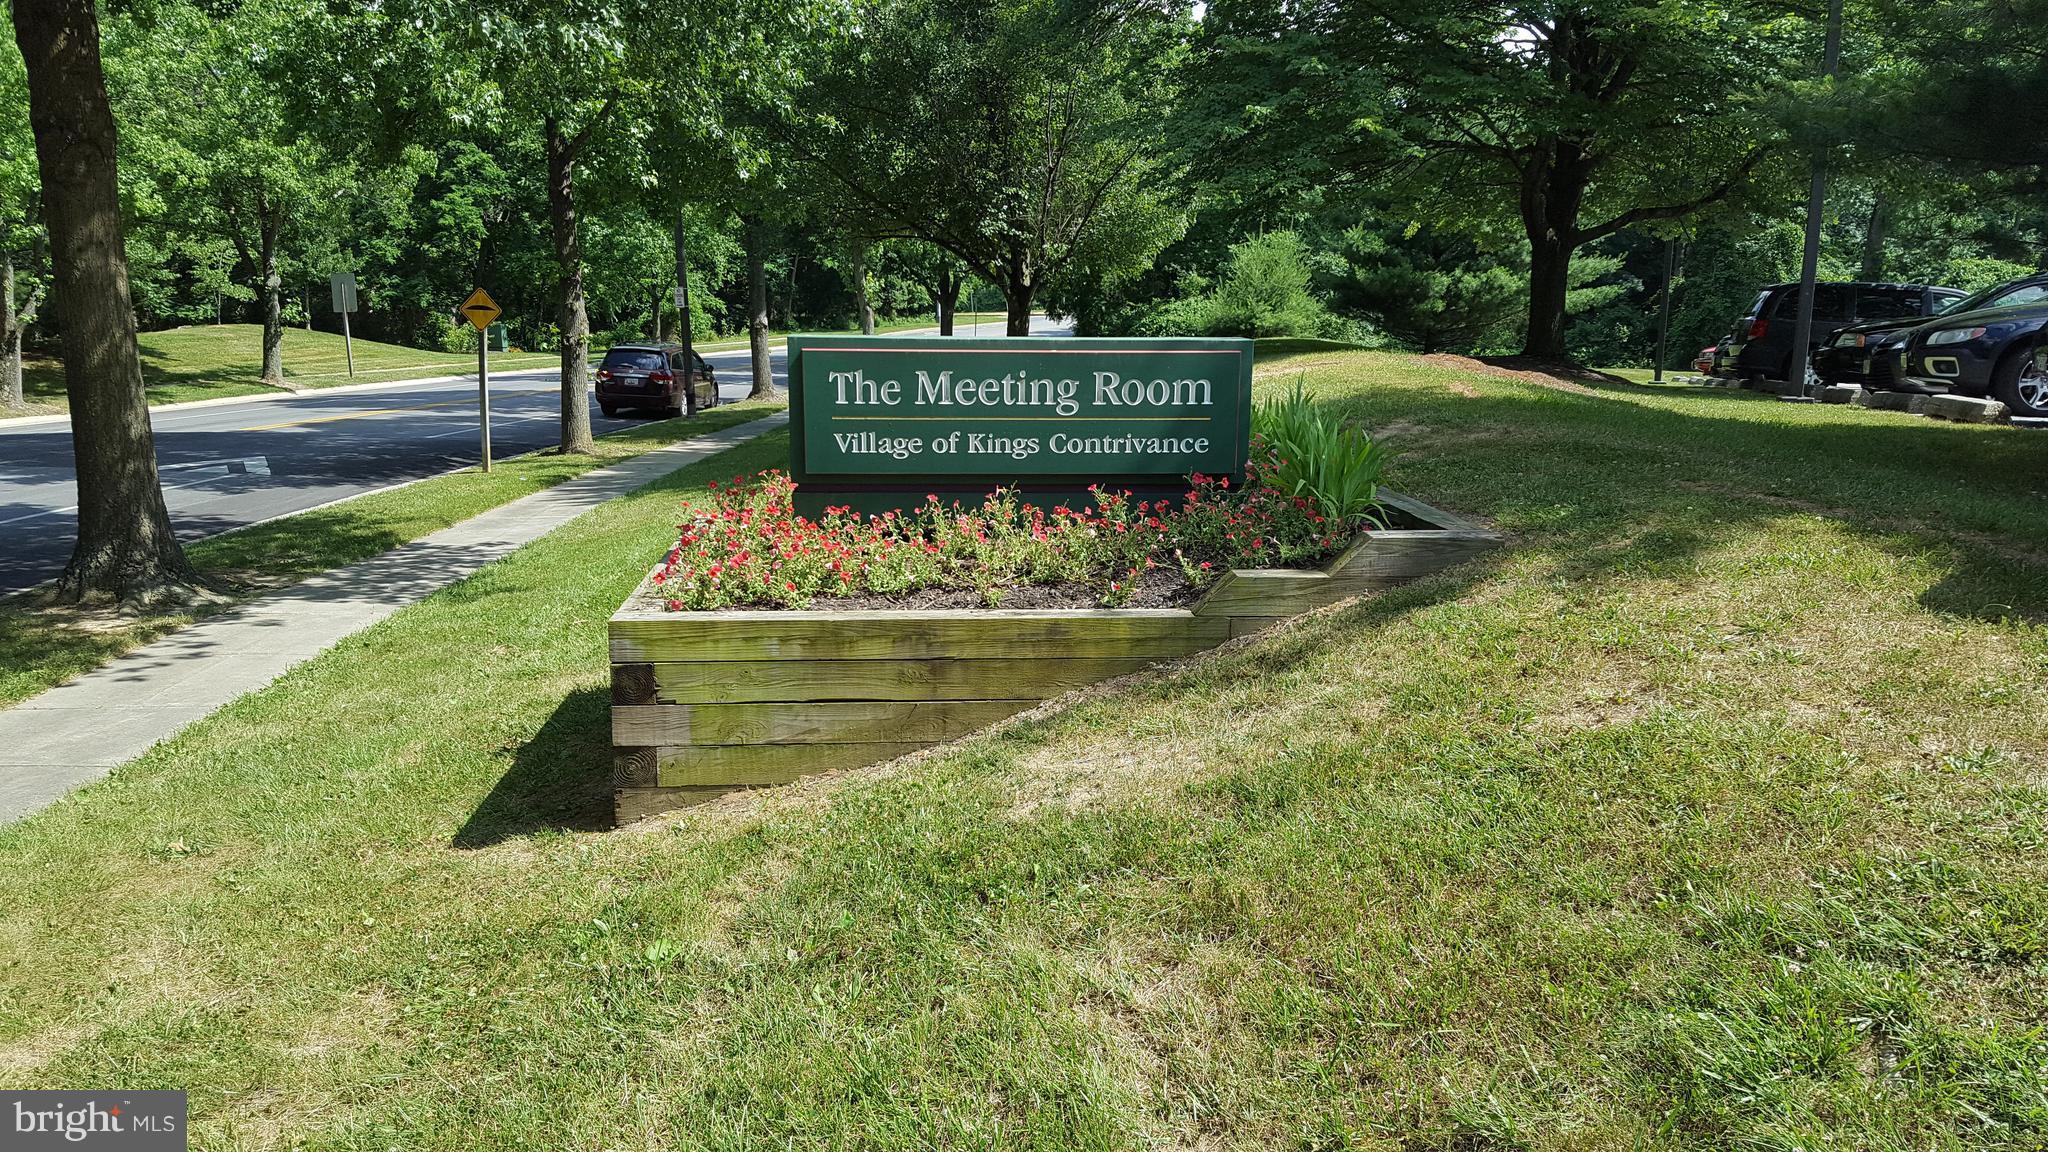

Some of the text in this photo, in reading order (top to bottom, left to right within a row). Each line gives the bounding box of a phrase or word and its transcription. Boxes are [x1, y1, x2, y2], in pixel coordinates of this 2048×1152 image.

[829, 370, 1213, 416] The Meeting Room
[833, 431, 1209, 459] Village of Kings Contrivance
